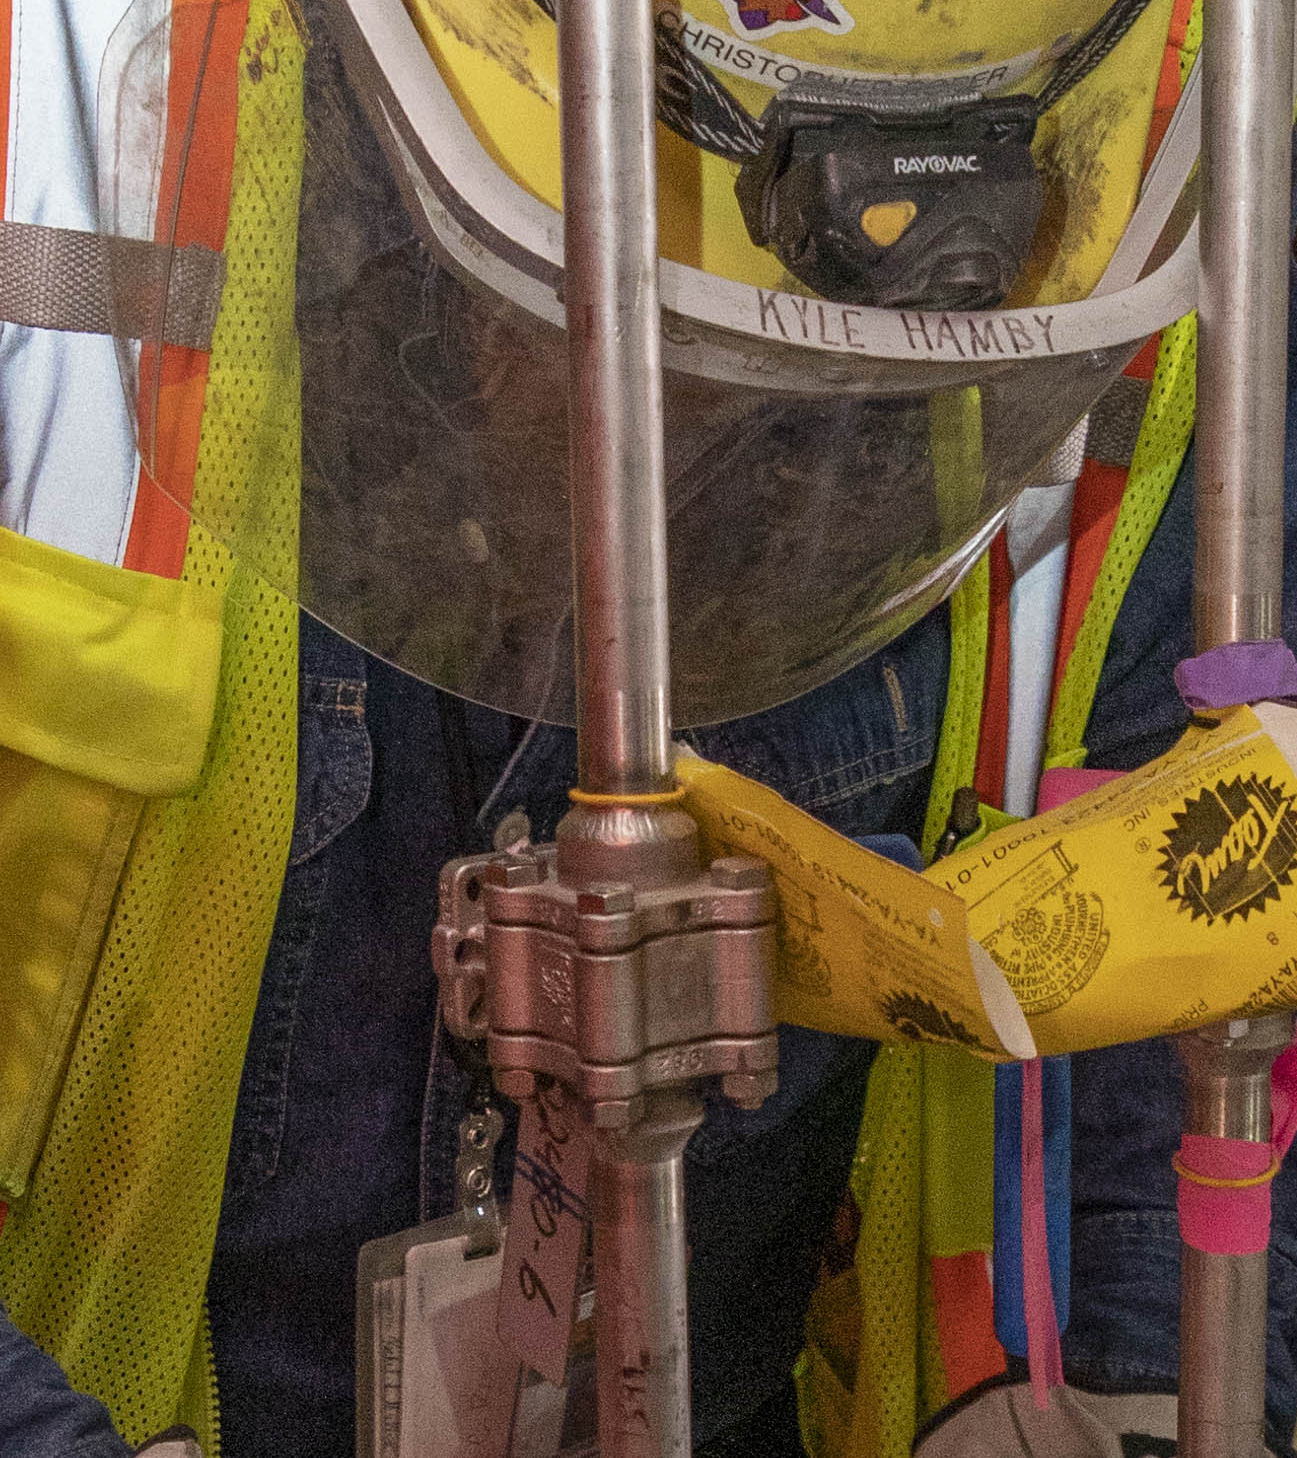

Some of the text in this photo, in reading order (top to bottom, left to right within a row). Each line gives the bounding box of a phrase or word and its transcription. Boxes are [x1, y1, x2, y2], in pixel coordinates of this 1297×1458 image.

[894, 155, 979, 174] RAYOVAC
[757, 288, 1055, 359] KYLE HAMBY
[1123, 804, 1152, 834] INC
[1177, 792, 1290, 898] Team
[1079, 911, 1100, 961] UNITED
